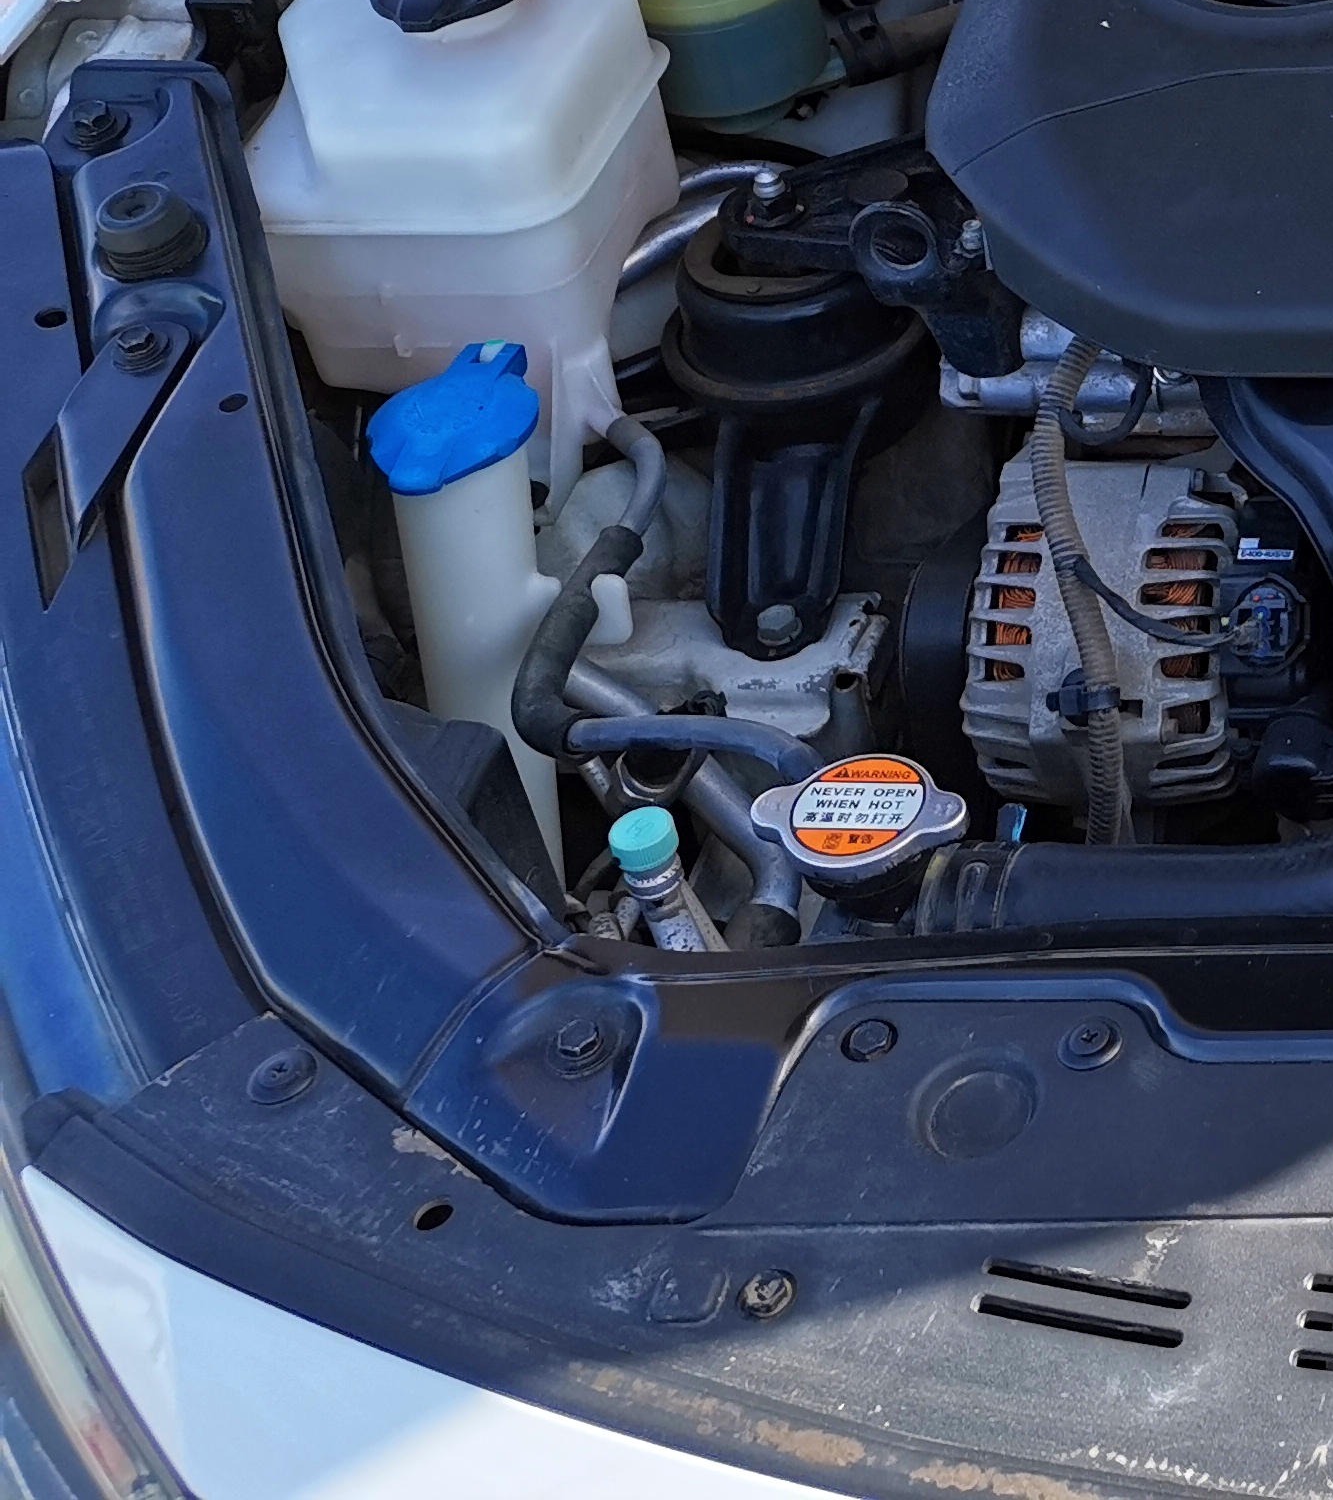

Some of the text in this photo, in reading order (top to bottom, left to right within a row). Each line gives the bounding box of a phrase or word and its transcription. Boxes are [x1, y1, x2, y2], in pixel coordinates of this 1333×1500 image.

[849, 768, 912, 780] WARNING
[810, 786, 918, 798] NEVER OPEN
[816, 799, 905, 810] WHEN HOT
[802, 811, 904, 824] 高温时勿打开
